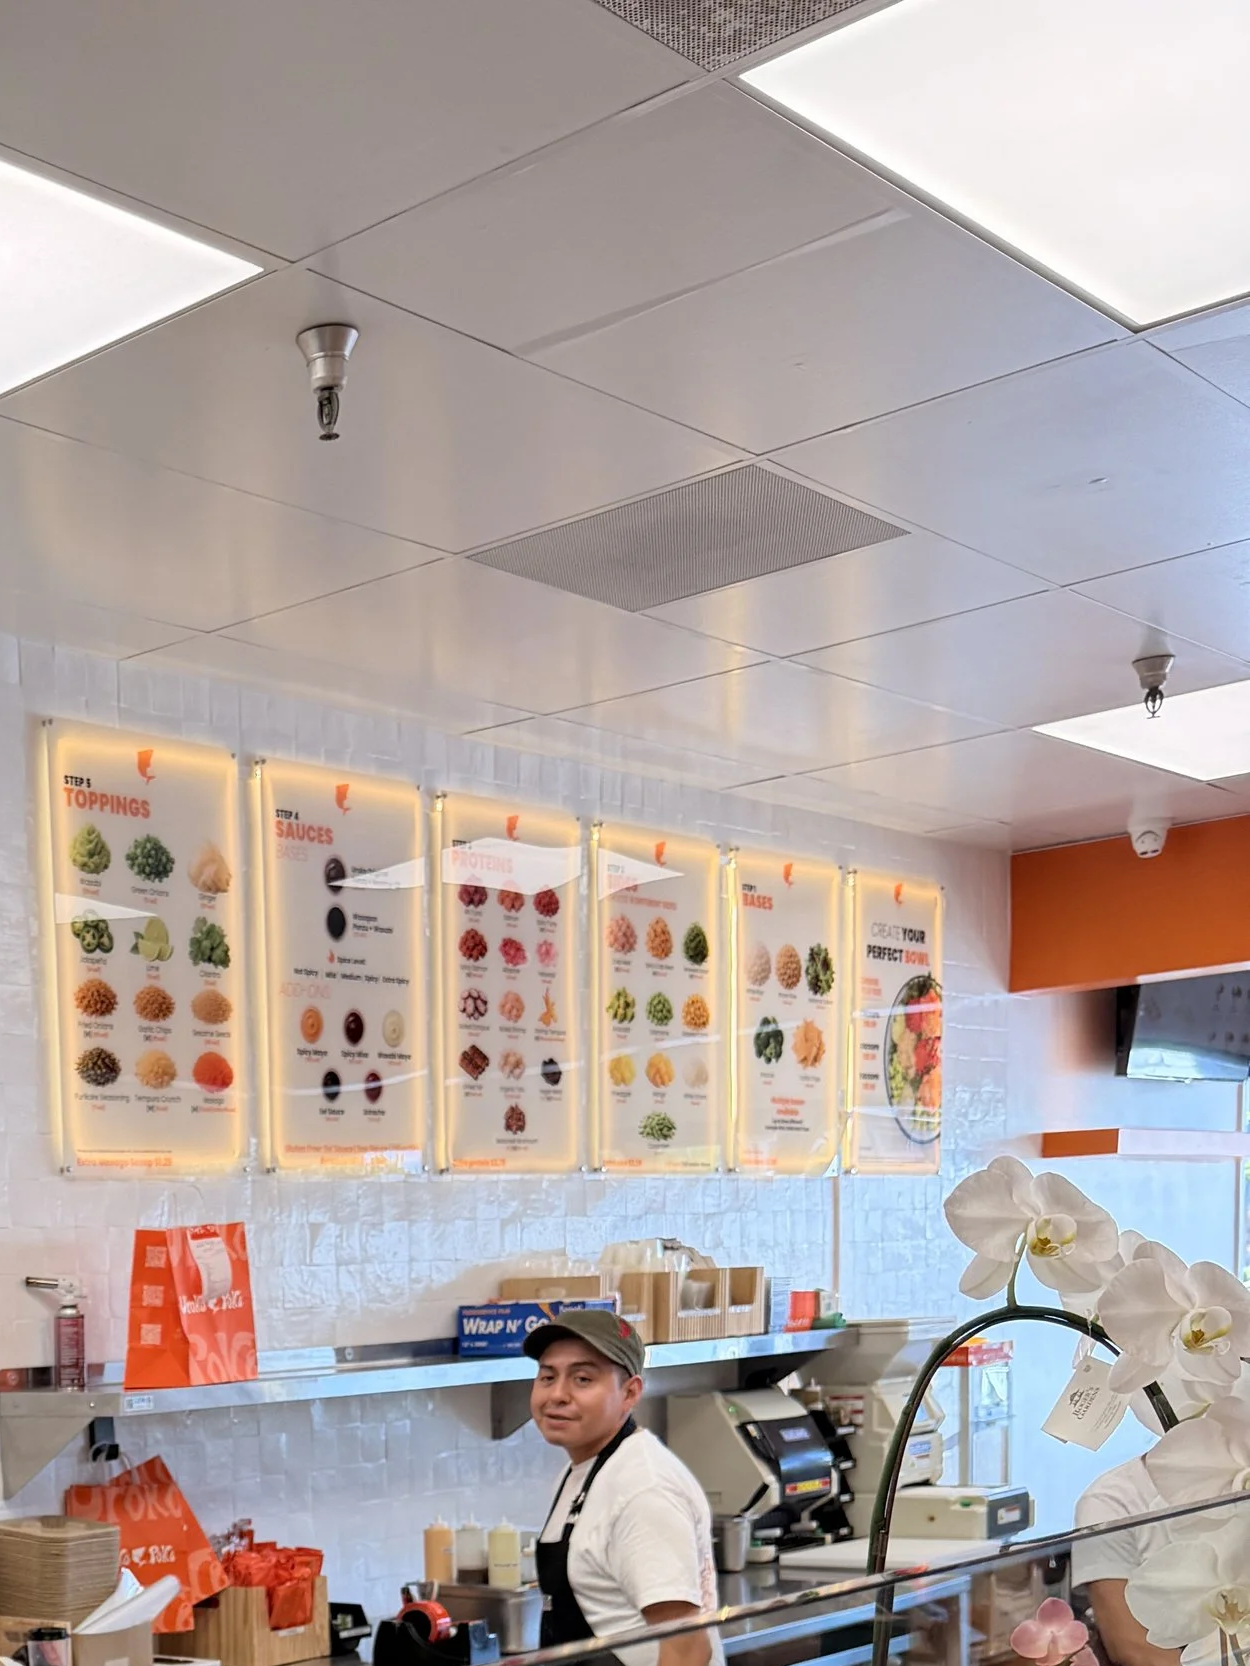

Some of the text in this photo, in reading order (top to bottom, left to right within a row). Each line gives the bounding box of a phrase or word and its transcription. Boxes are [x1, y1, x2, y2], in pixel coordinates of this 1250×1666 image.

[63, 775, 92, 789] STEP 5
[62, 786, 151, 819] TOPPINGS
[275, 809, 299, 821] STEP 4
[275, 819, 334, 845] SAUCES
[452, 849, 513, 874] PROTEINS
[131, 886, 149, 895] Green
[742, 892, 773, 911] BASES
[871, 921, 926, 944] CREATE YOUR
[866, 944, 930, 967] PERFECT BOWL
[279, 981, 331, 999] ADD-ONS
[462, 1317, 522, 1336] WRAP N'
